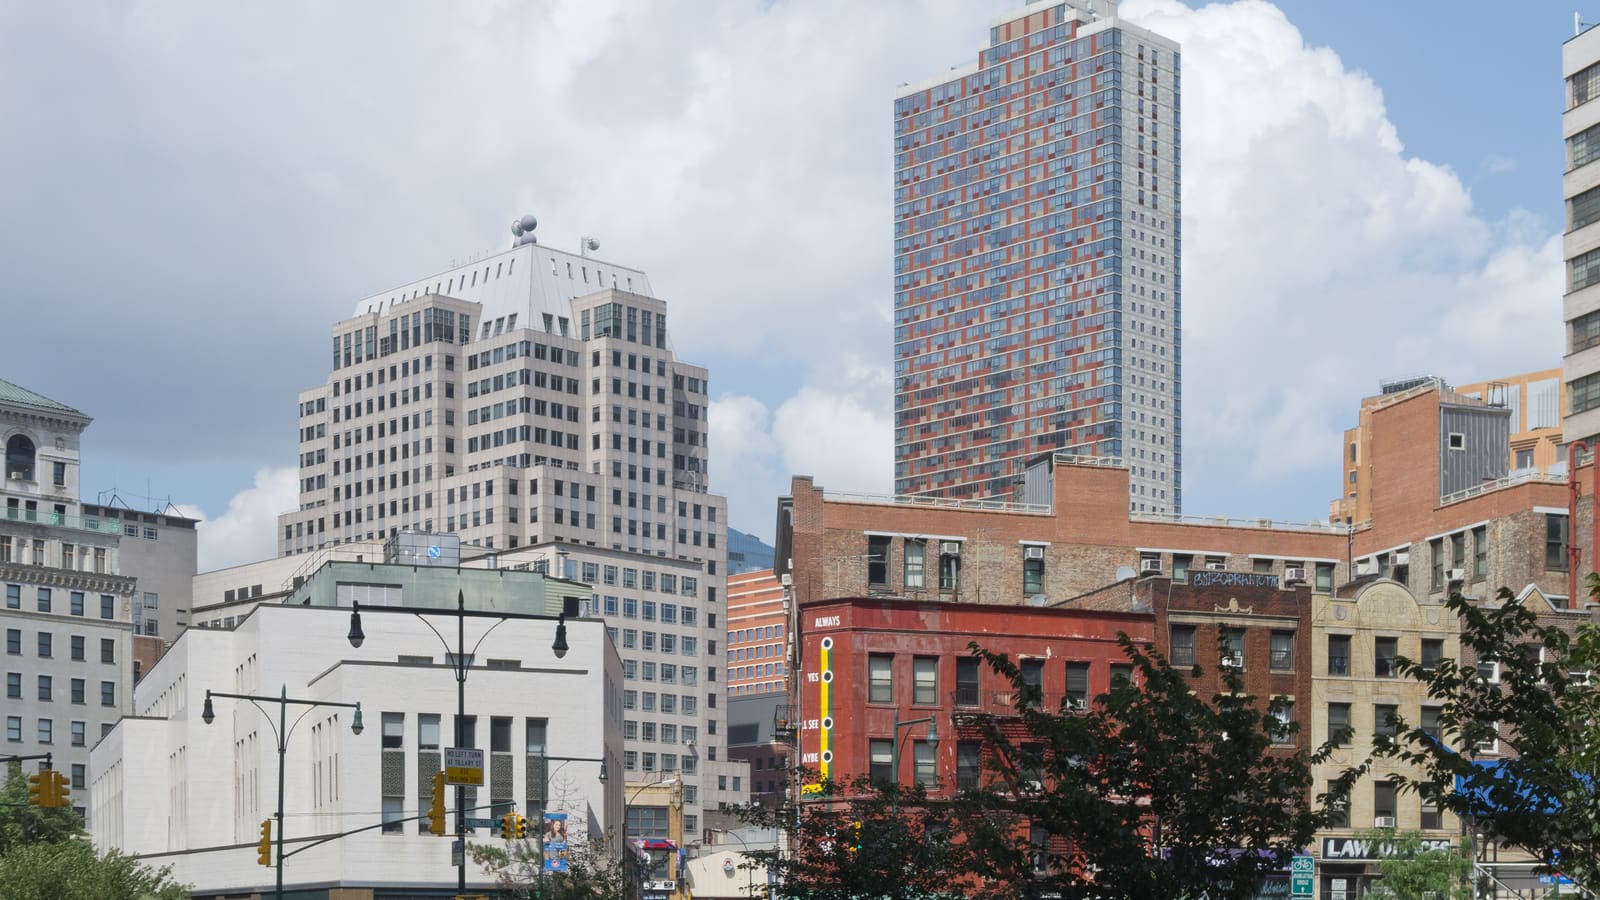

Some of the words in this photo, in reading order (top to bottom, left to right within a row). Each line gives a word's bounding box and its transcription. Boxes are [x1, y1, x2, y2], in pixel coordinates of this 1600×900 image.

[815, 616, 840, 628] ALWAYS
[807, 672, 819, 682] YES
[808, 719, 819, 729] SEE
[1327, 839, 1372, 858] LAW
[1379, 840, 1450, 857] OCES
